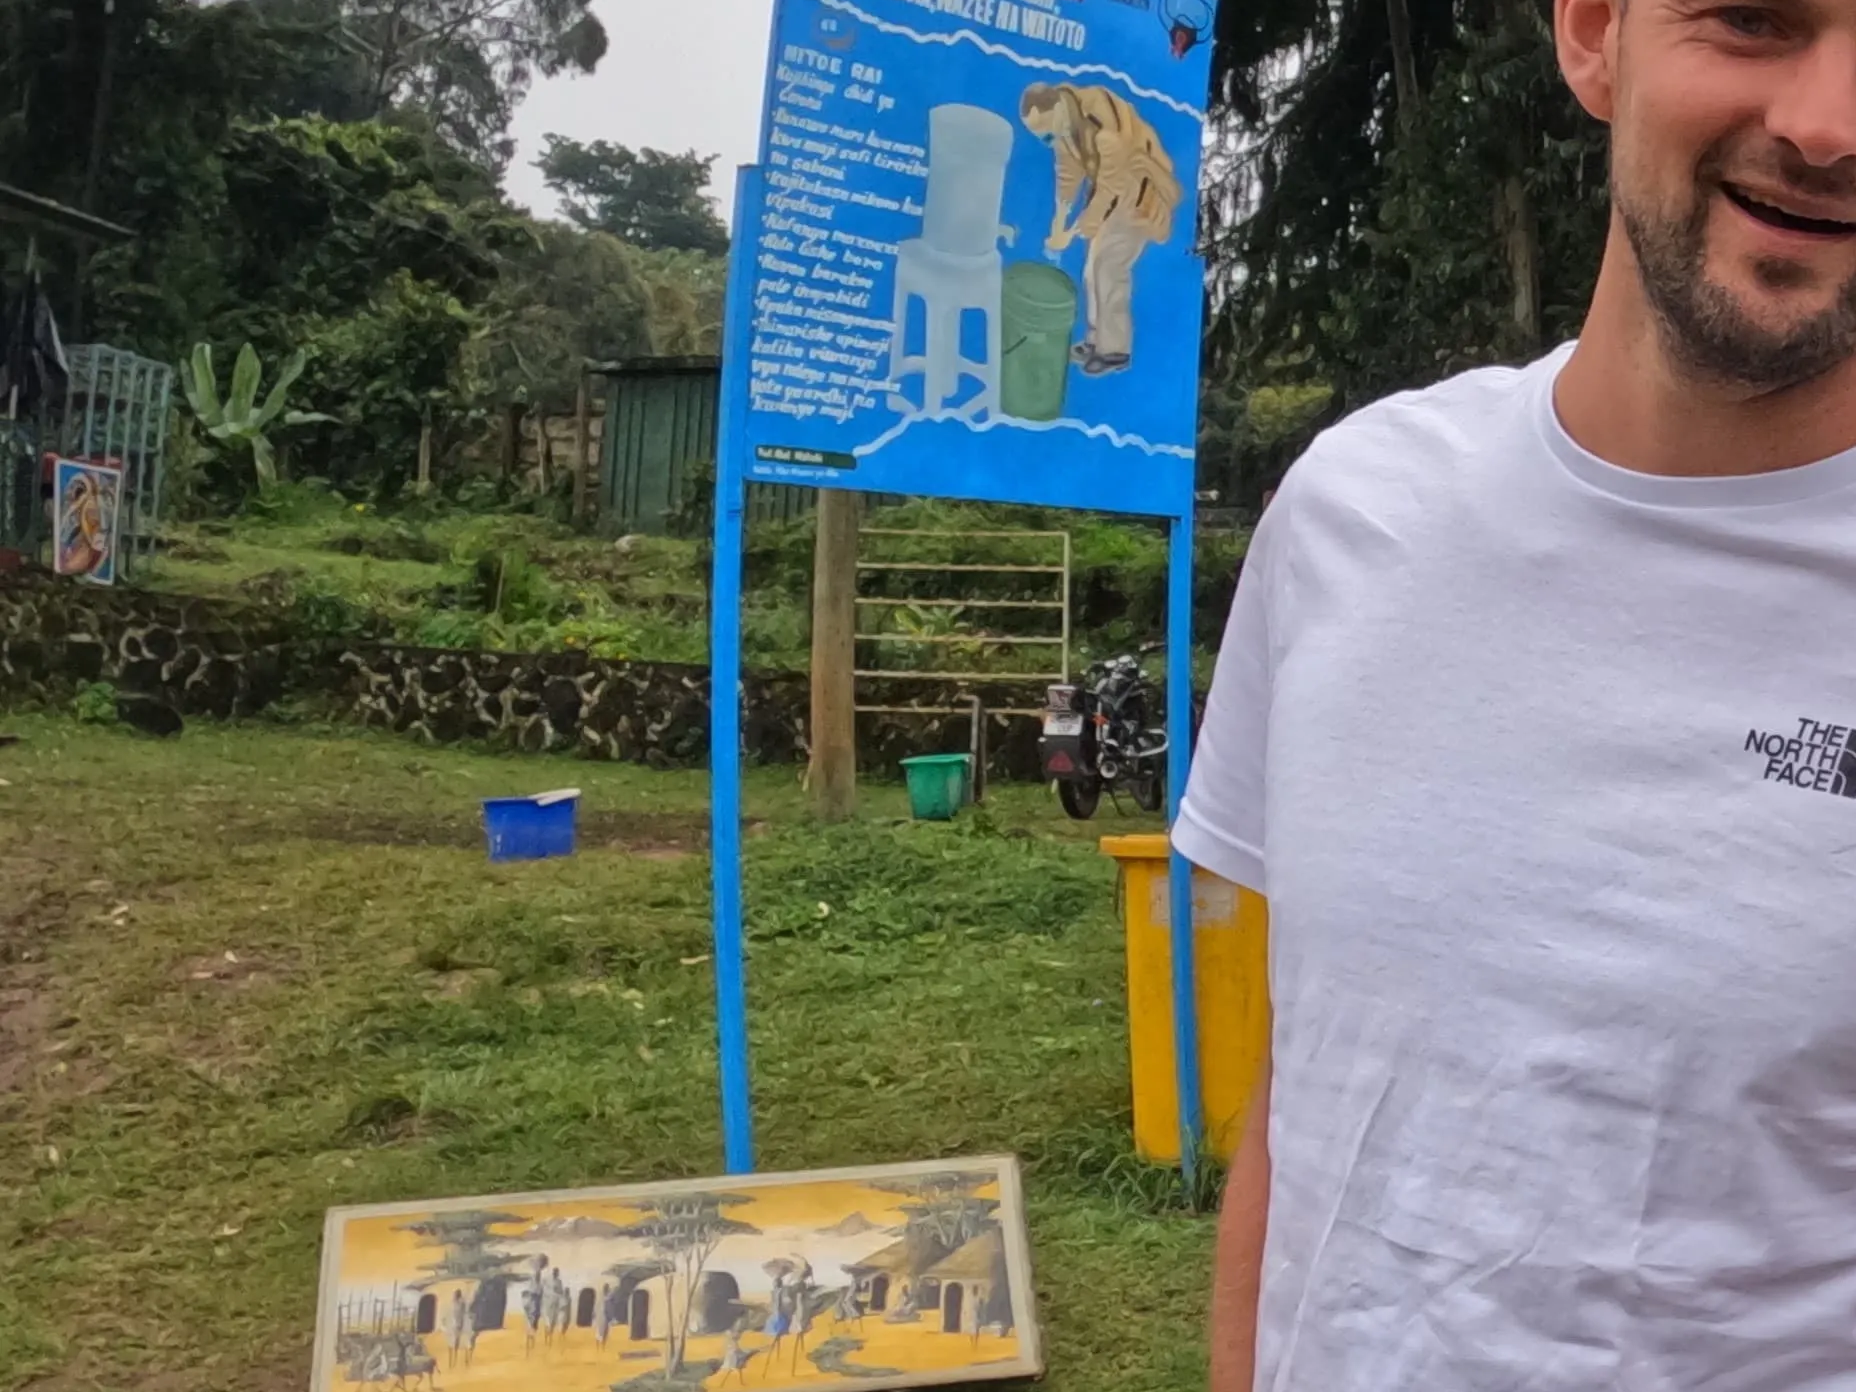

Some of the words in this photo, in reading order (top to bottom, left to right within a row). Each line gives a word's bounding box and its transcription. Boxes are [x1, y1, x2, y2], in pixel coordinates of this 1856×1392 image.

[995, 0, 1018, 32] NA
[1021, 7, 1086, 51] WATOTO
[1744, 728, 1840, 770] NORTH
[1798, 717, 1848, 747] THE
[1763, 759, 1832, 792] FACE
